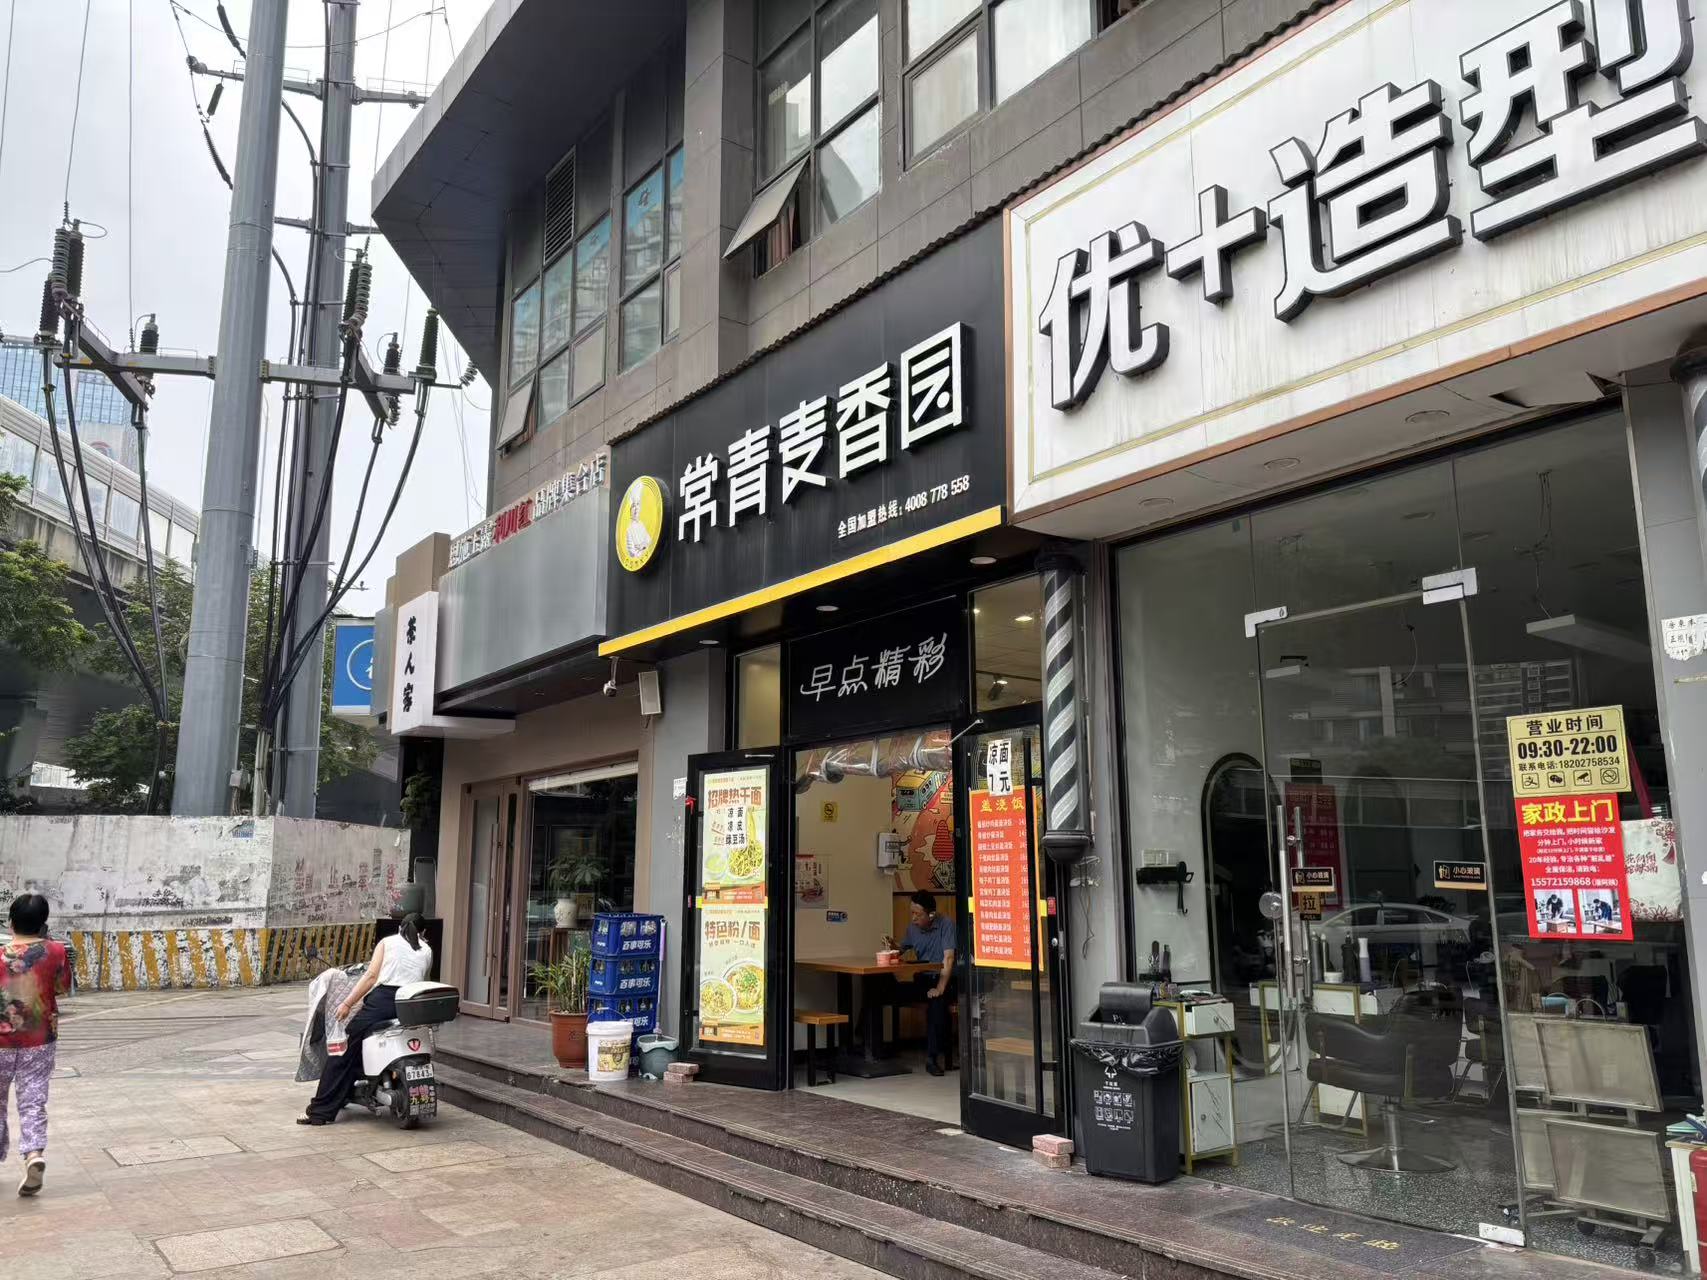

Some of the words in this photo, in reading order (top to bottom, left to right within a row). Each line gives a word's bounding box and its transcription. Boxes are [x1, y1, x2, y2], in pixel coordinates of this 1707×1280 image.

[678, 321, 963, 542] 常青麦香园
[930, 483, 948, 504] 778
[951, 475, 970, 496] 558
[800, 632, 947, 702] 早点精彩
[1526, 714, 1604, 736] 营业时间
[989, 743, 1009, 765] 凉面
[1518, 735, 1618, 759] 09:30-22:00
[708, 786, 762, 808] 招牌热干面
[980, 796, 1025, 813] 盖浇饭
[1521, 799, 1615, 825] 家政上门
[725, 833, 746, 846] 绿豆汤
[1303, 895, 1317, 911] 拉
[705, 921, 760, 941] 特色粉/面
[622, 939, 652, 951] 百事可乐
[619, 977, 651, 989] 百事可乐
